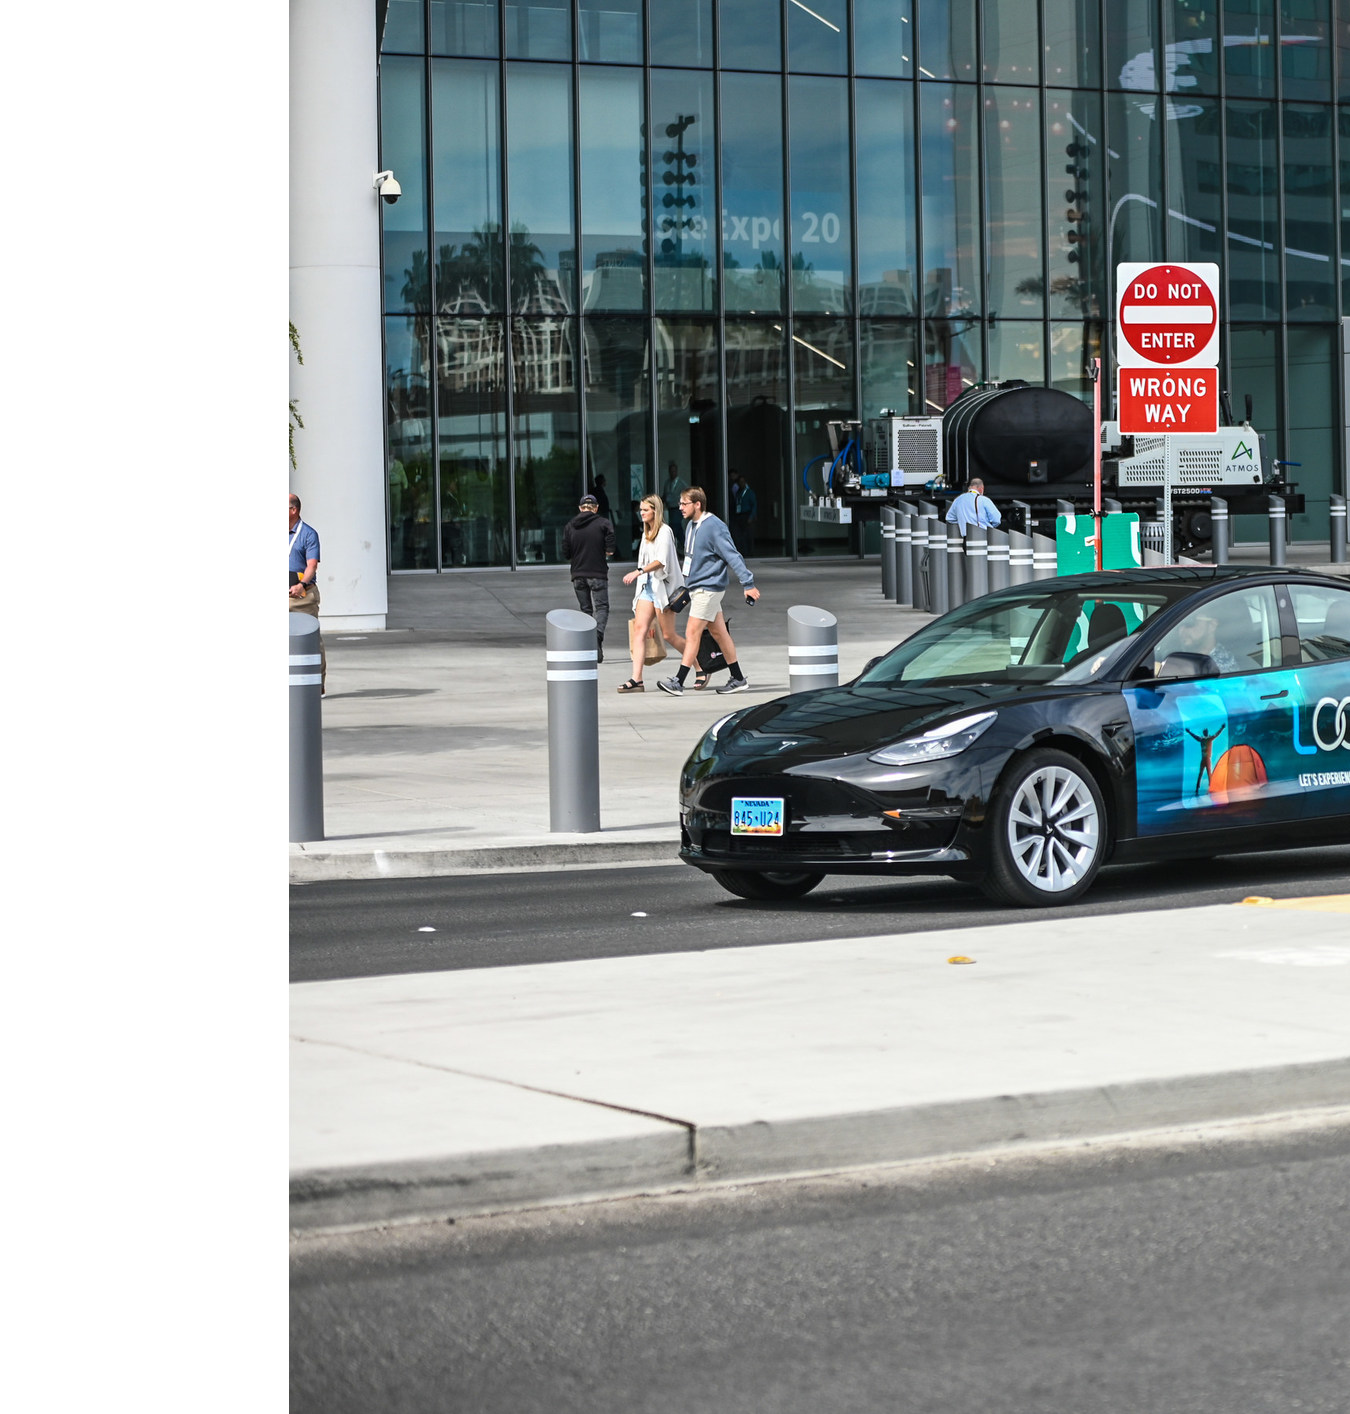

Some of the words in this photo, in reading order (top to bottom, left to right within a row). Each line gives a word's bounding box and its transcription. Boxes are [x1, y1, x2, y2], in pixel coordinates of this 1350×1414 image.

[801, 212, 841, 243] 20
[1134, 284, 1158, 299] DO
[1168, 284, 1202, 299] NOT
[1141, 333, 1195, 348] ENTER
[1130, 378, 1207, 397] WRONG
[1145, 404, 1191, 423] WAY
[1298, 773, 1319, 787] LET'S
